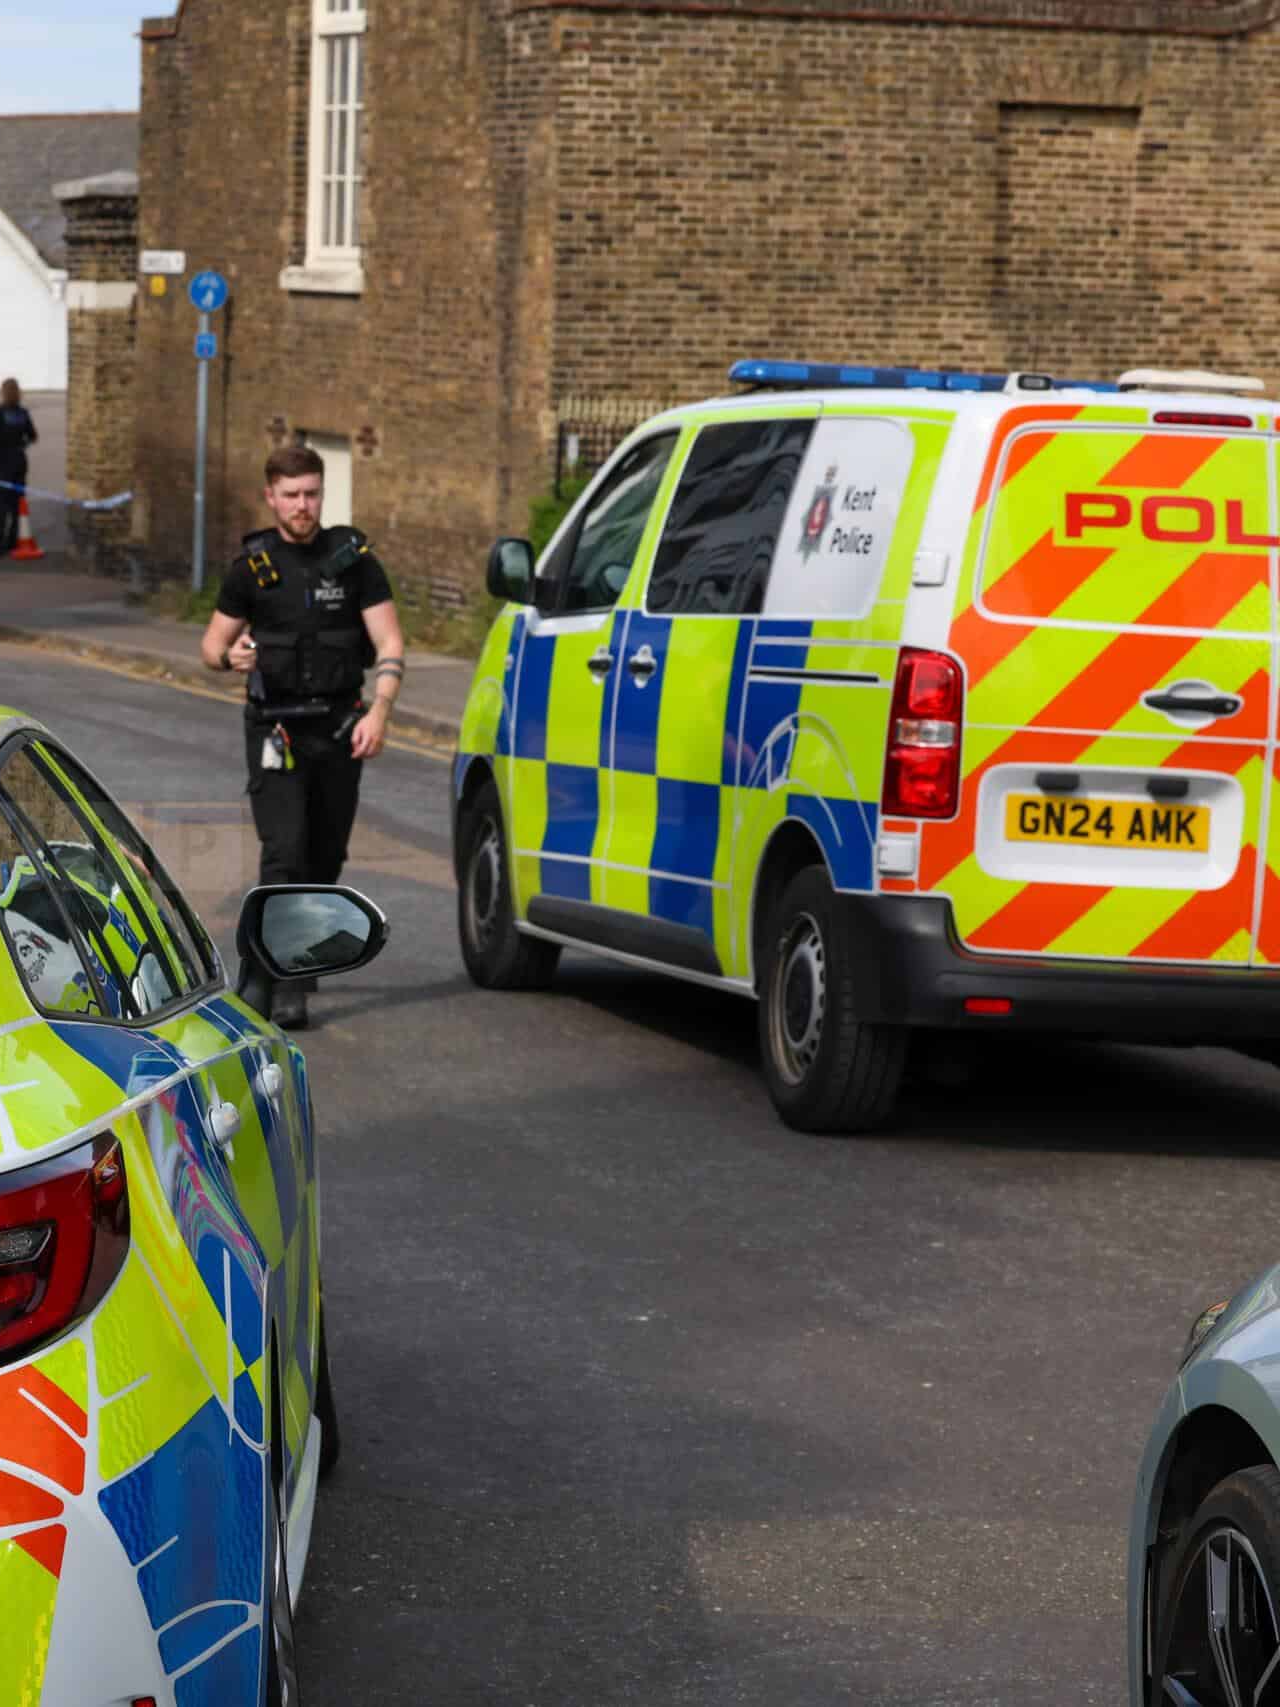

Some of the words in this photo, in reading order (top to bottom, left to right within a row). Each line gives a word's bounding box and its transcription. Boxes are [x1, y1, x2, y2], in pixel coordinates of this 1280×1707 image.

[841, 485, 876, 511] Kent
[1065, 492, 1280, 546] POL
[830, 527, 872, 554] Police
[1019, 802, 1114, 838] GN24
[1128, 809, 1196, 844] AMK
